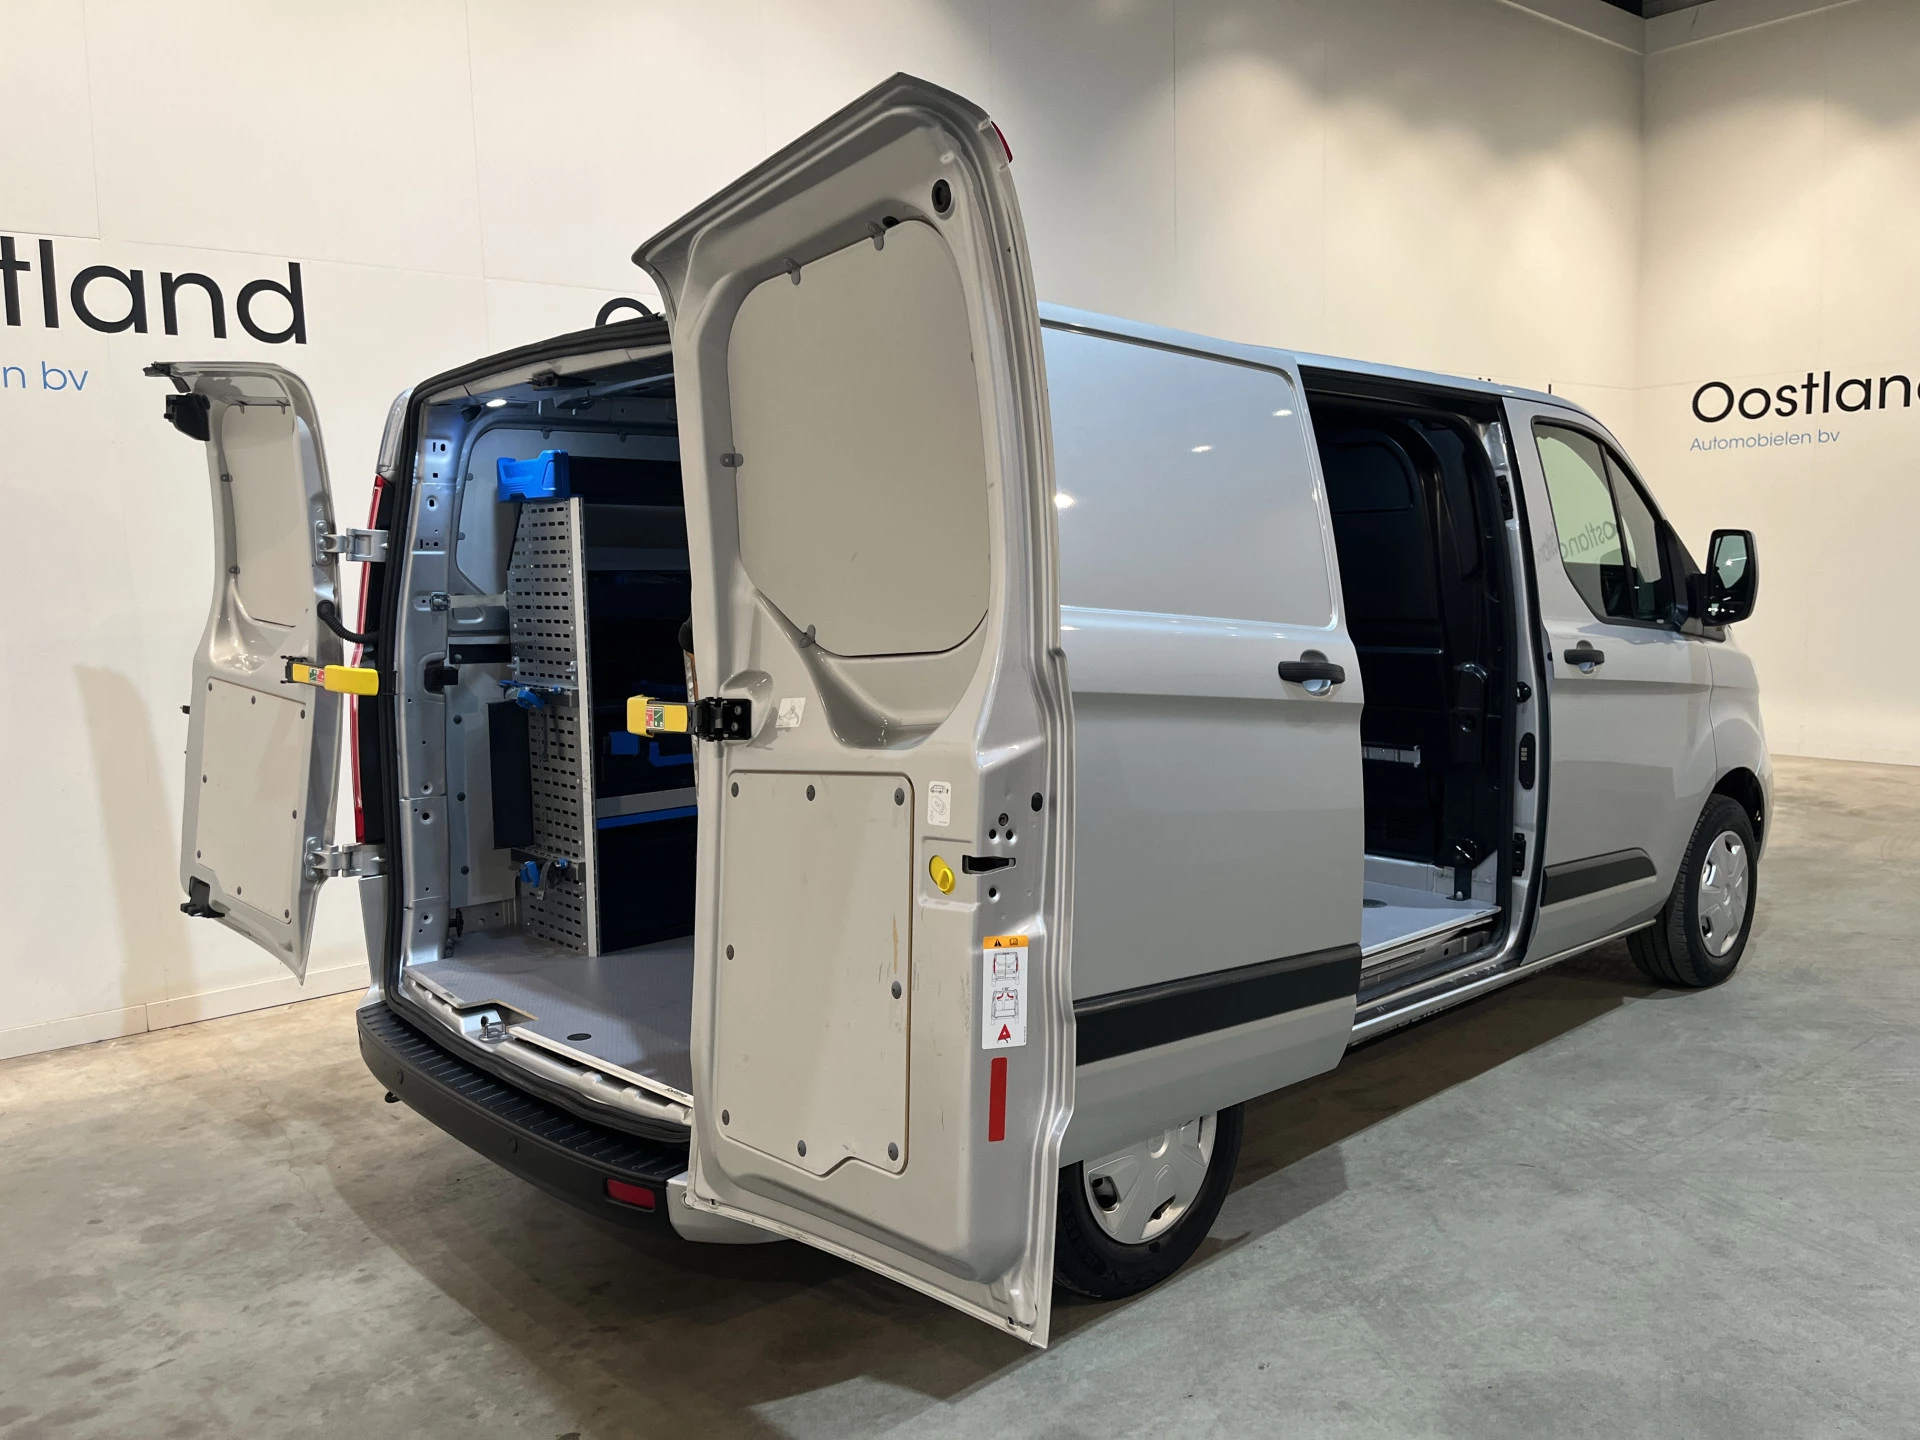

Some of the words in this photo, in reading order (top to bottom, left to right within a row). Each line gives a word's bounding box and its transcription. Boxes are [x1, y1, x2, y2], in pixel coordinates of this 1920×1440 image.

[41, 360, 89, 391] bv
[1692, 370, 1920, 423] Oostlan
[1689, 430, 1811, 452] Automobielen
[1817, 428, 1840, 444] bv
